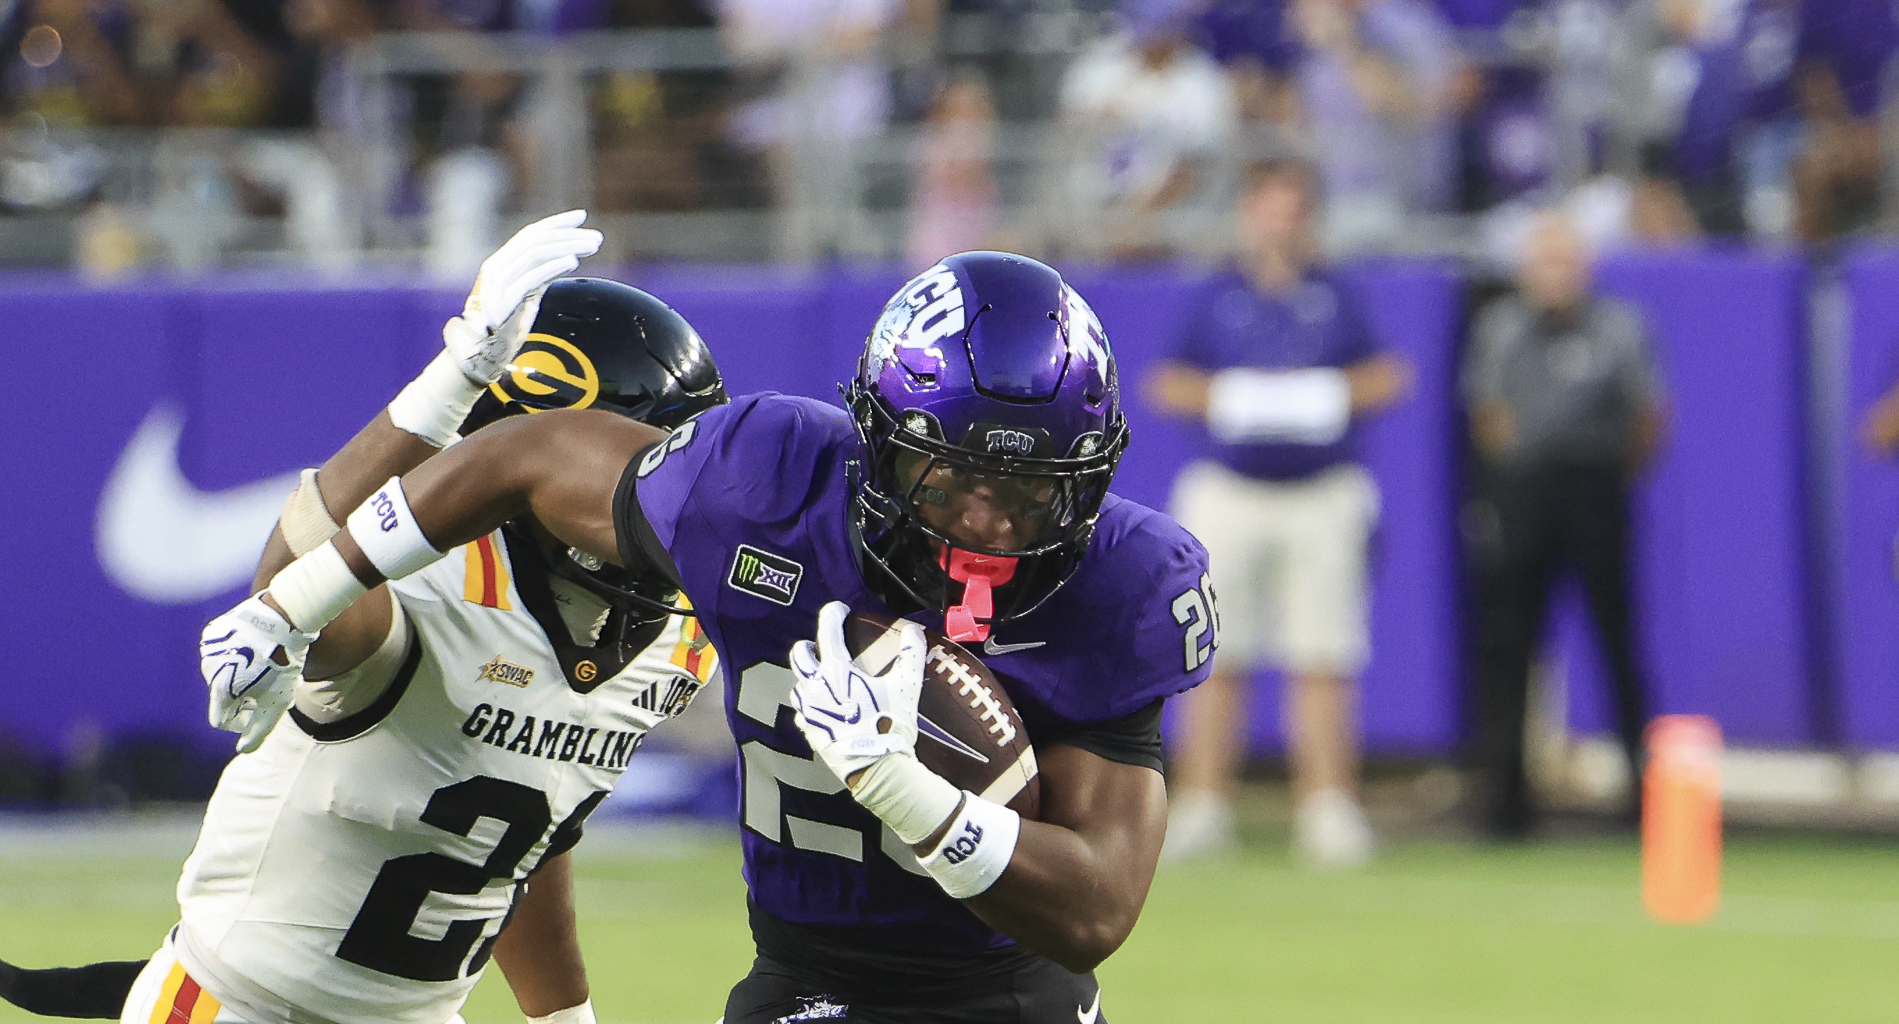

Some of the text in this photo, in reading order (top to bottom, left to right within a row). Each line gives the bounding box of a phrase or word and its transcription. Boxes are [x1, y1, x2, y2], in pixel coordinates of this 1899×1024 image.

[986, 430, 1035, 456] TCU
[370, 491, 399, 532] TCU
[499, 661, 534, 685] SWAC
[942, 820, 984, 865] TCU
